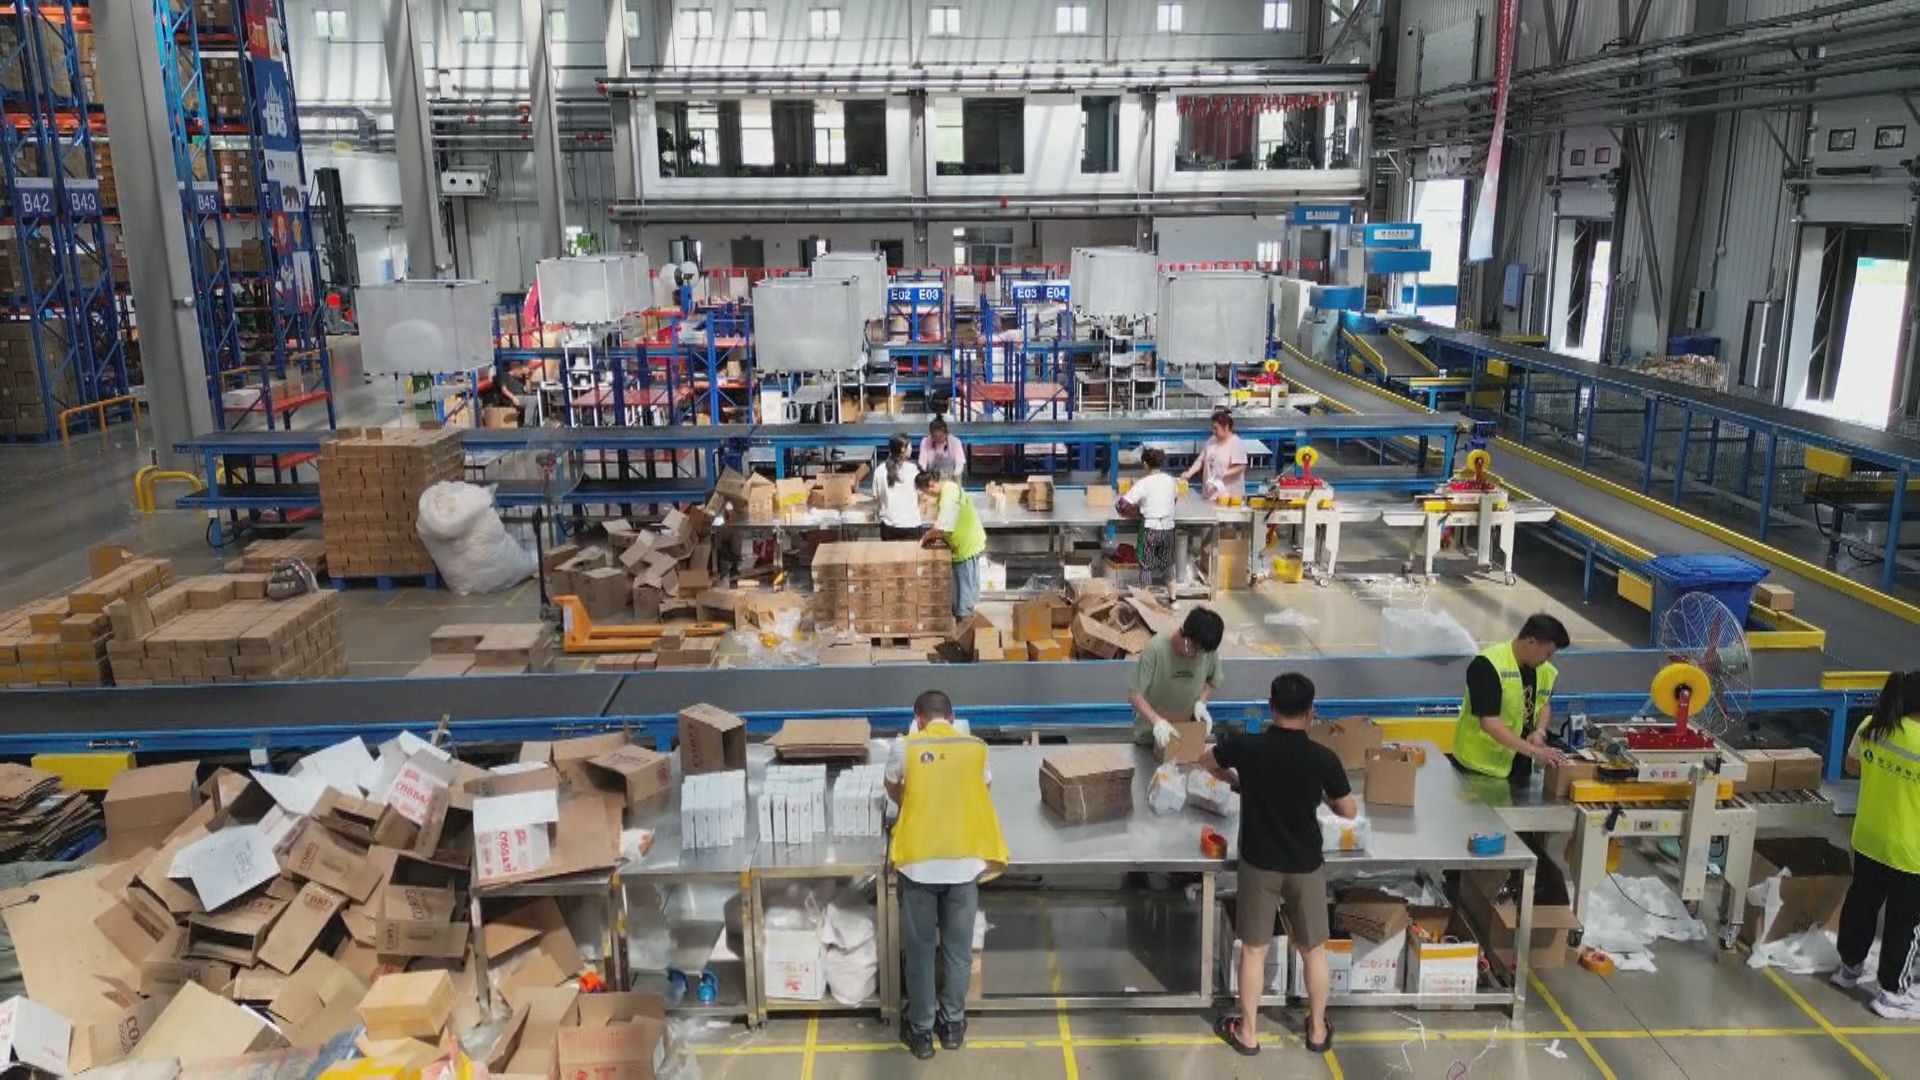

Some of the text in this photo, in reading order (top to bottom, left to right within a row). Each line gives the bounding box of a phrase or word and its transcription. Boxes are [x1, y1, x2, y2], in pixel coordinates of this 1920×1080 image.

[22, 193, 51, 212] B42
[71, 193, 97, 210] B43
[197, 195, 217, 211] B45
[891, 289, 939, 300] E02 E03
[1046, 286, 1067, 298] E04
